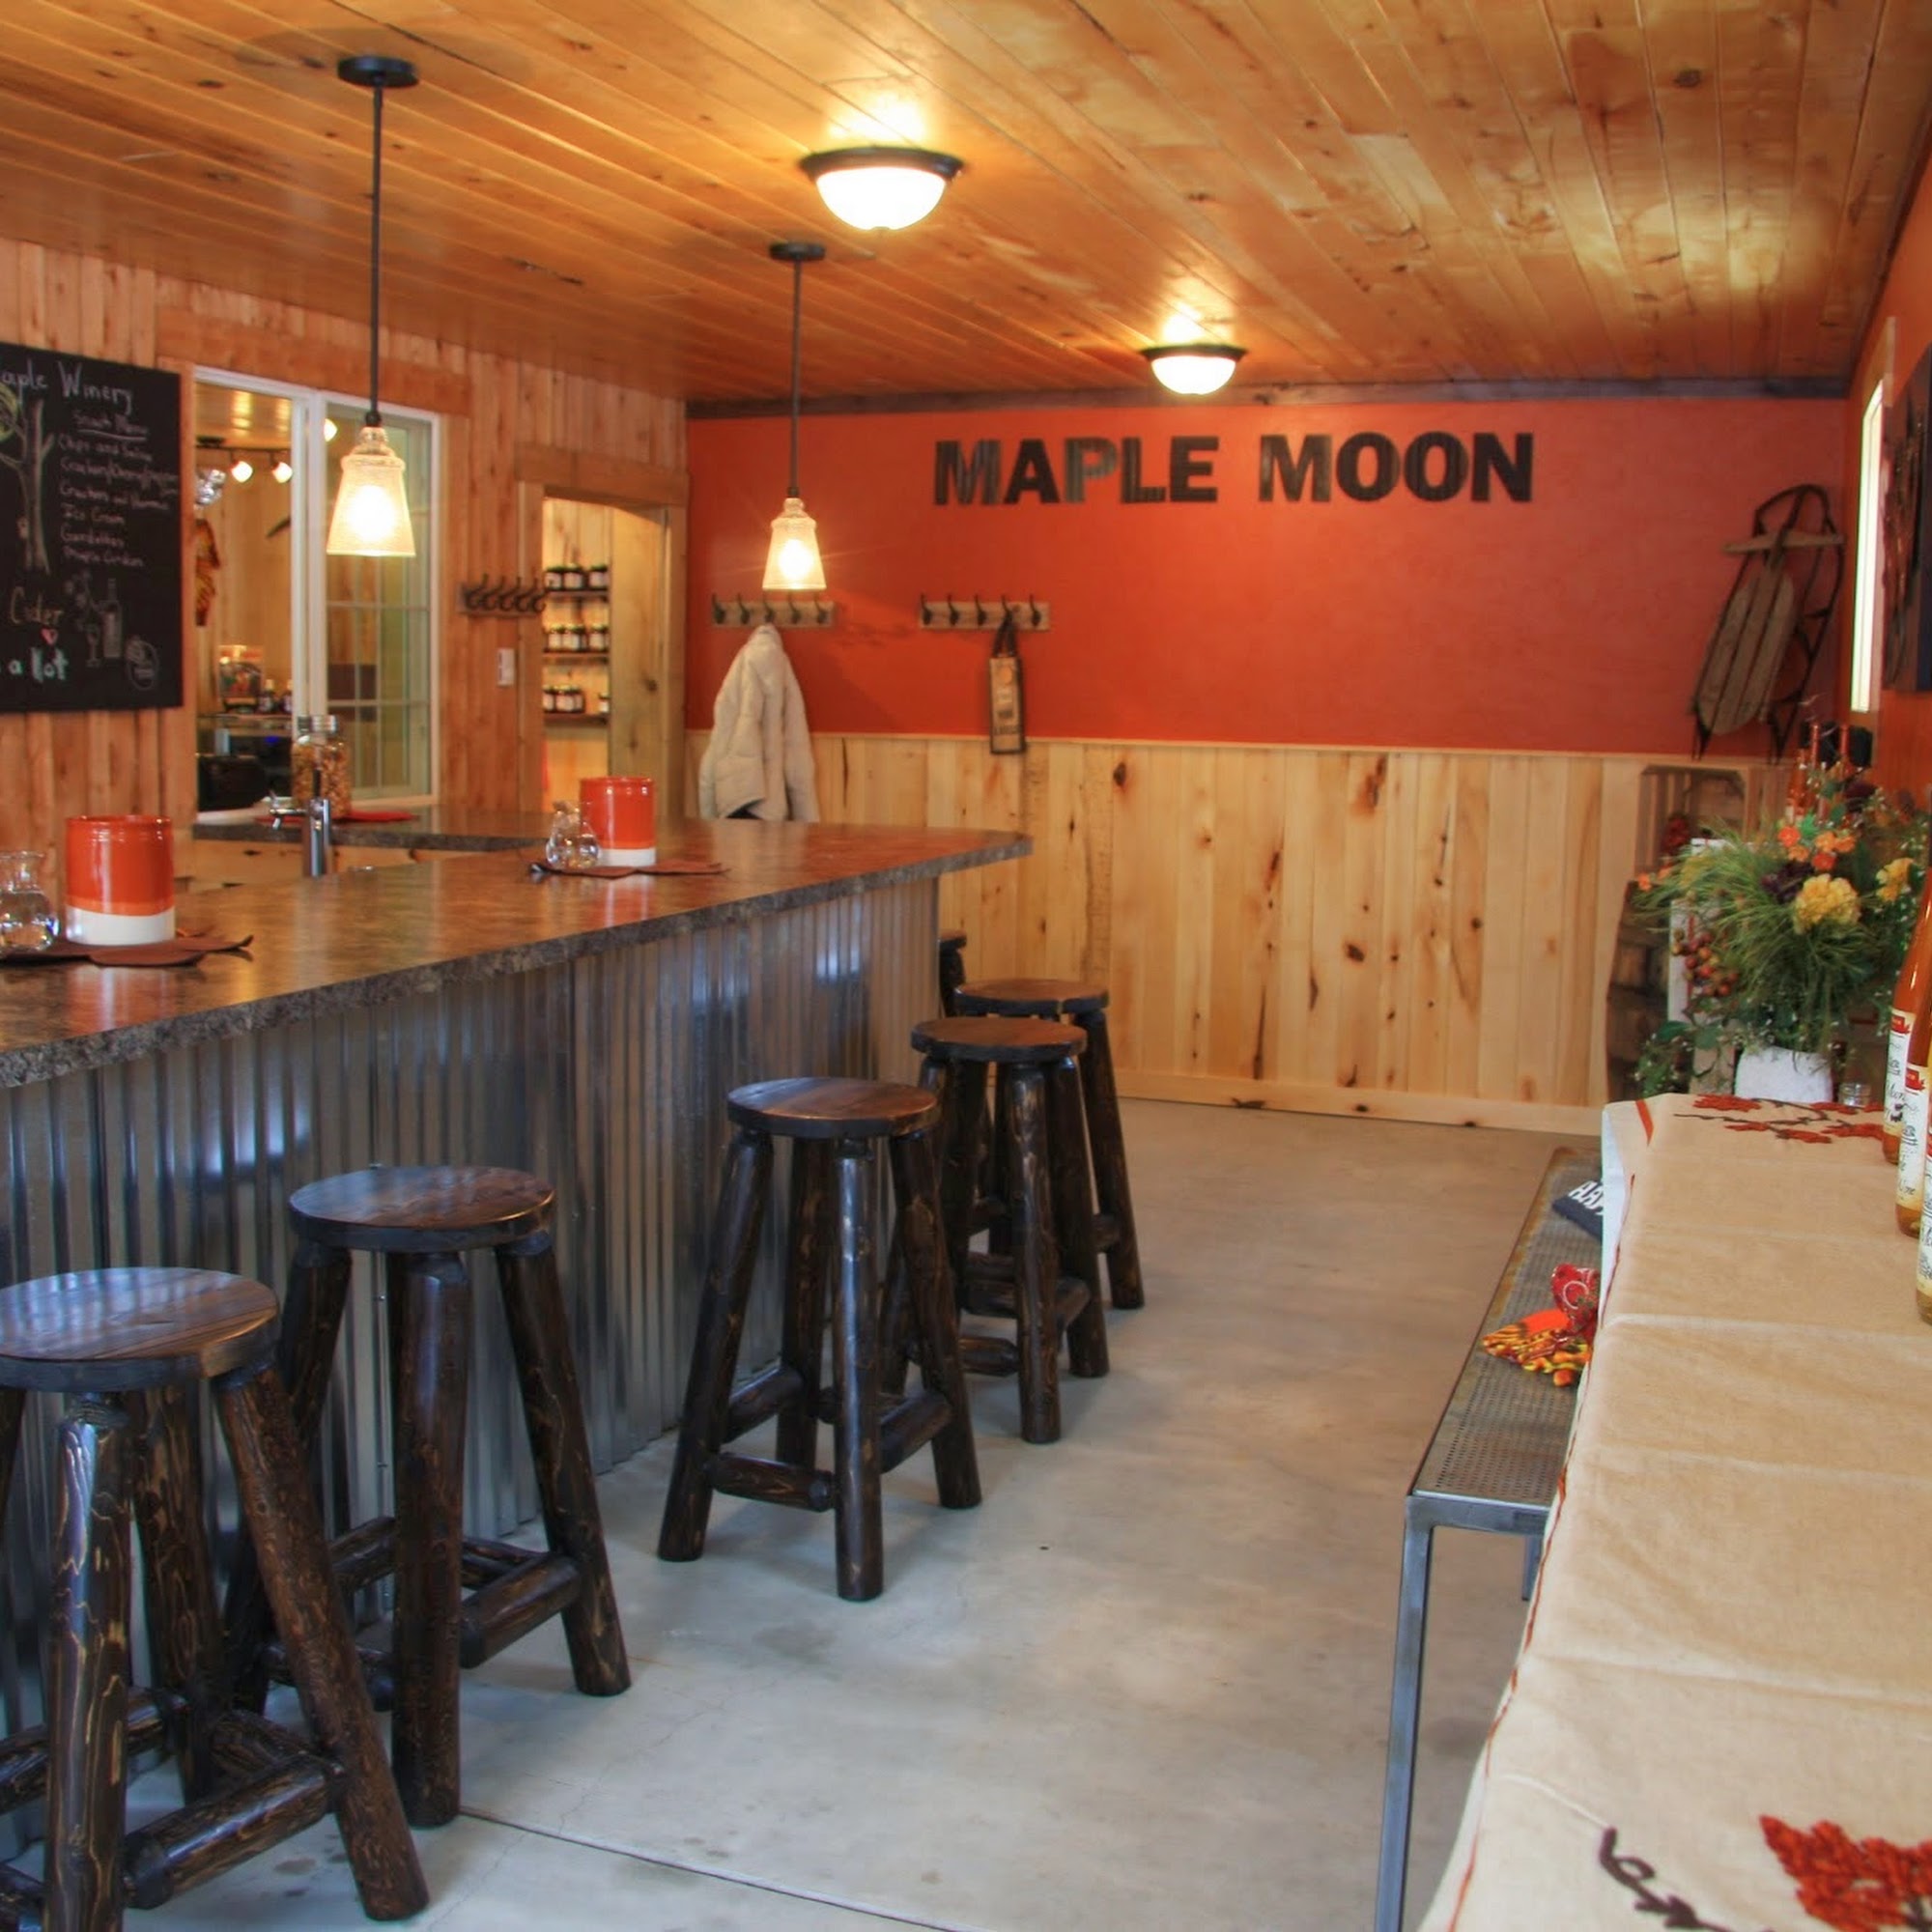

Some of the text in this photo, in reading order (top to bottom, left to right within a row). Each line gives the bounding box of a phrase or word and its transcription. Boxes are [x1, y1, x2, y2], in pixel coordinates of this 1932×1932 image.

[56, 359, 132, 414] Winery
[934, 431, 1534, 505] MAPLE MOON
[10, 584, 64, 625] Cider
[30, 647, 69, 683] lot
